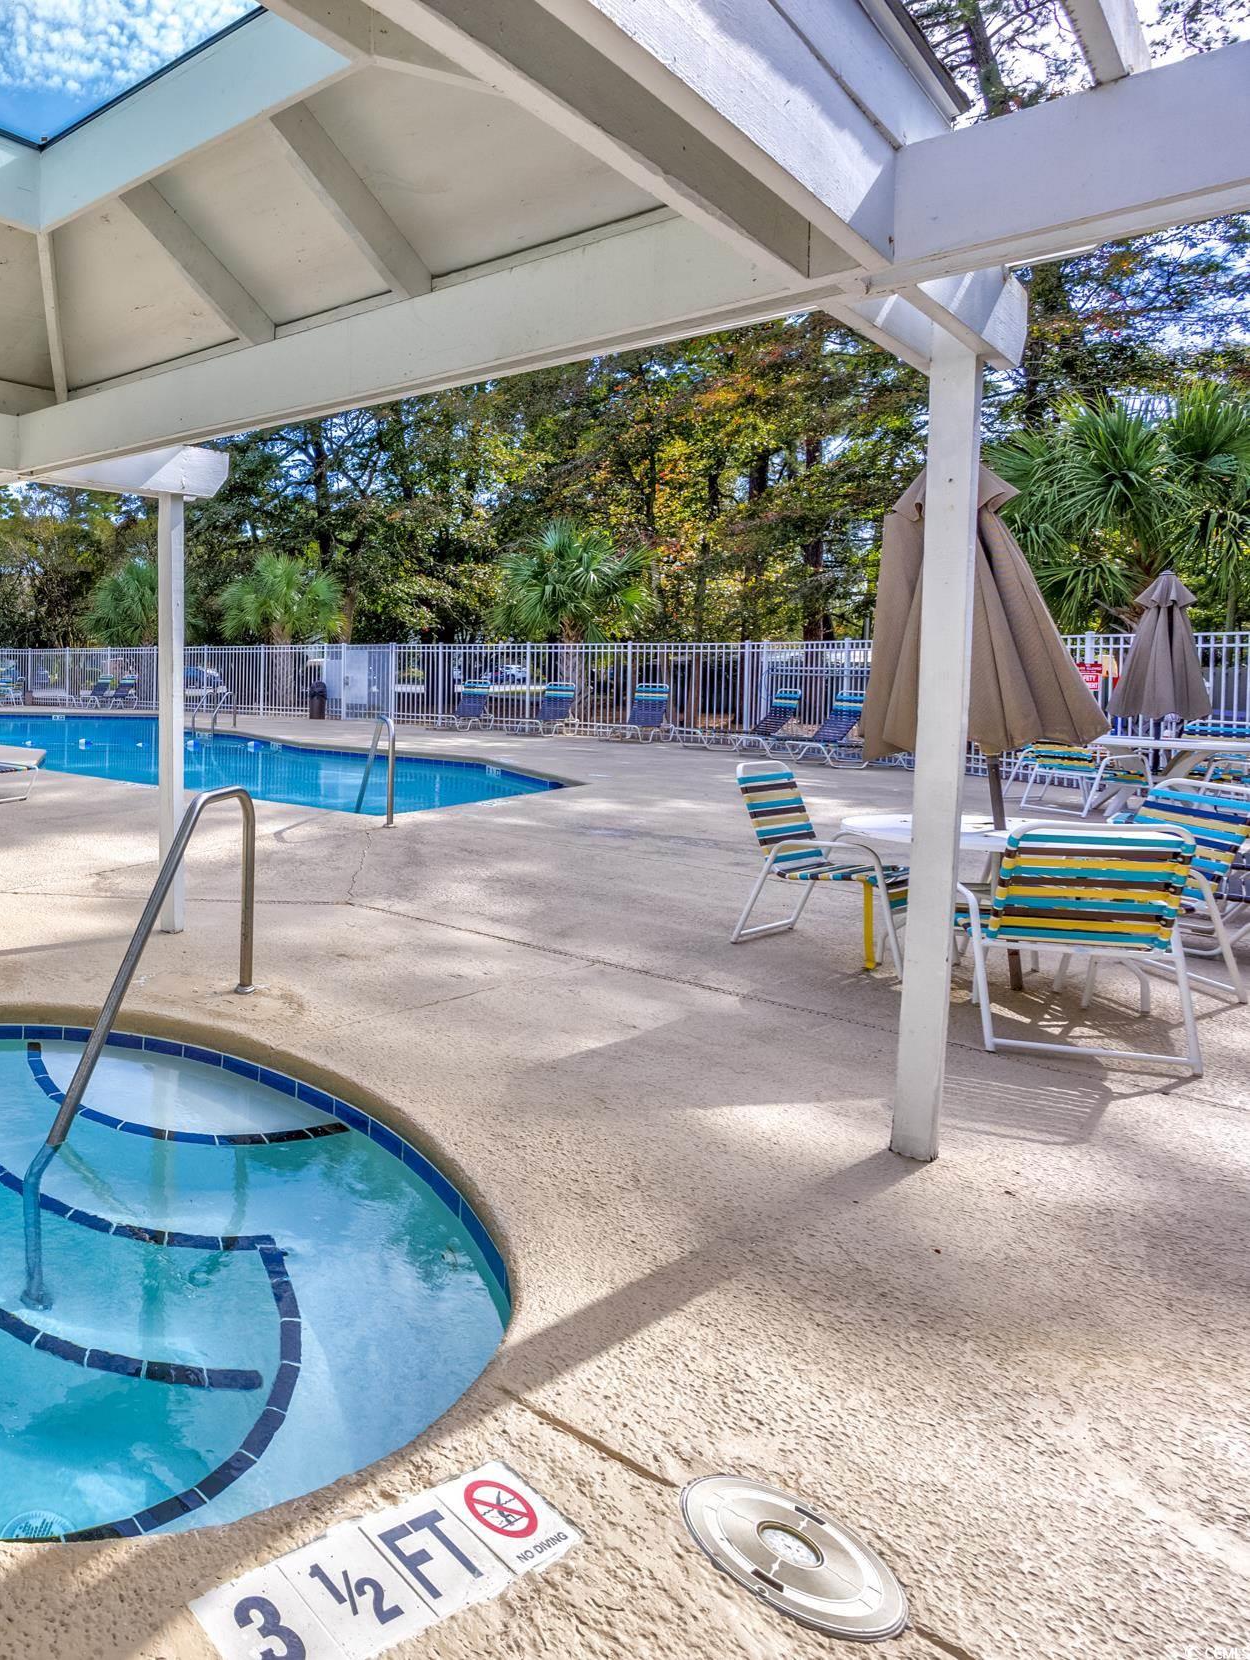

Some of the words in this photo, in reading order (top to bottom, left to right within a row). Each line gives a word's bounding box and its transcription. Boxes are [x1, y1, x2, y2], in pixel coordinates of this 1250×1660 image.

[233, 1596, 307, 1660] 3
[377, 1509, 484, 1600] FT
[516, 1550, 535, 1563] NO
[533, 1532, 568, 1554] DIVING
